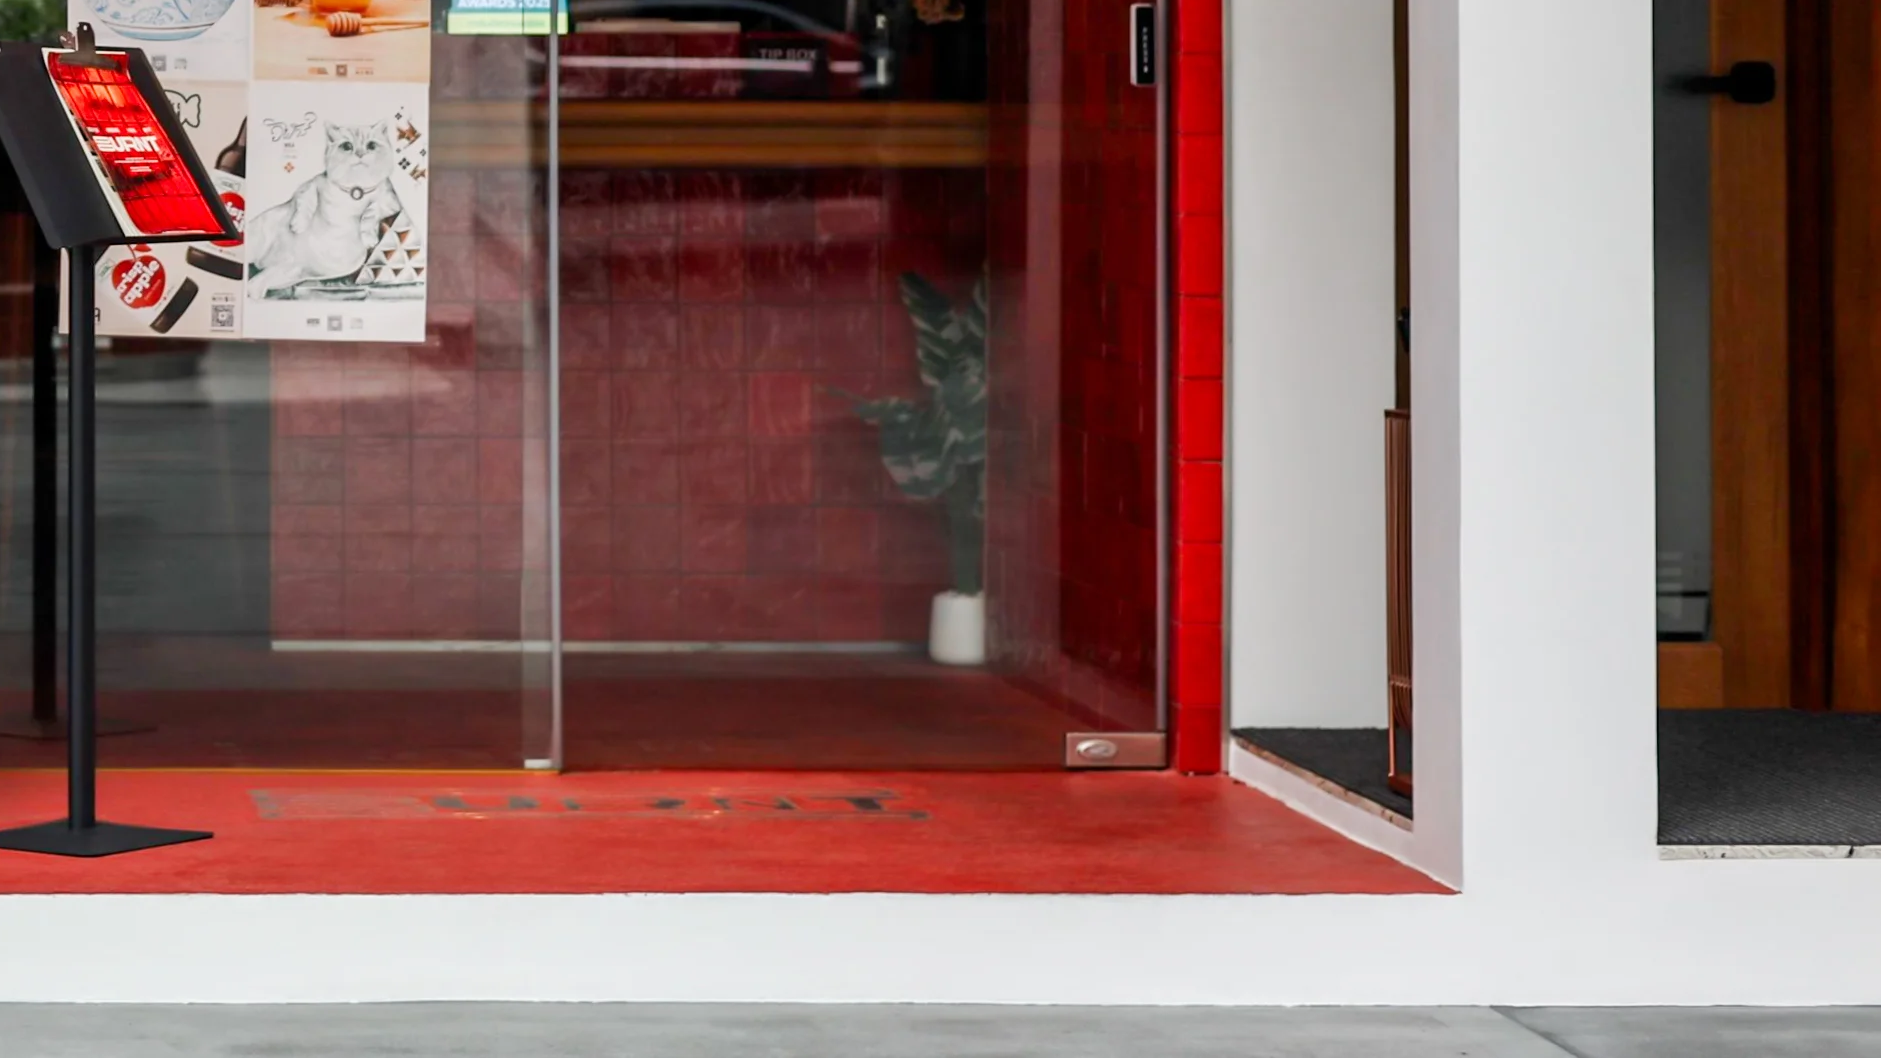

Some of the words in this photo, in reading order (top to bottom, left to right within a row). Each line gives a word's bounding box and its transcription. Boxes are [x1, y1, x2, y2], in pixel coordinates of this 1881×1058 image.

[758, 48, 783, 60] TIP
[786, 48, 817, 61] BOX
[92, 135, 160, 153] BURNT
[123, 260, 160, 304] apple
